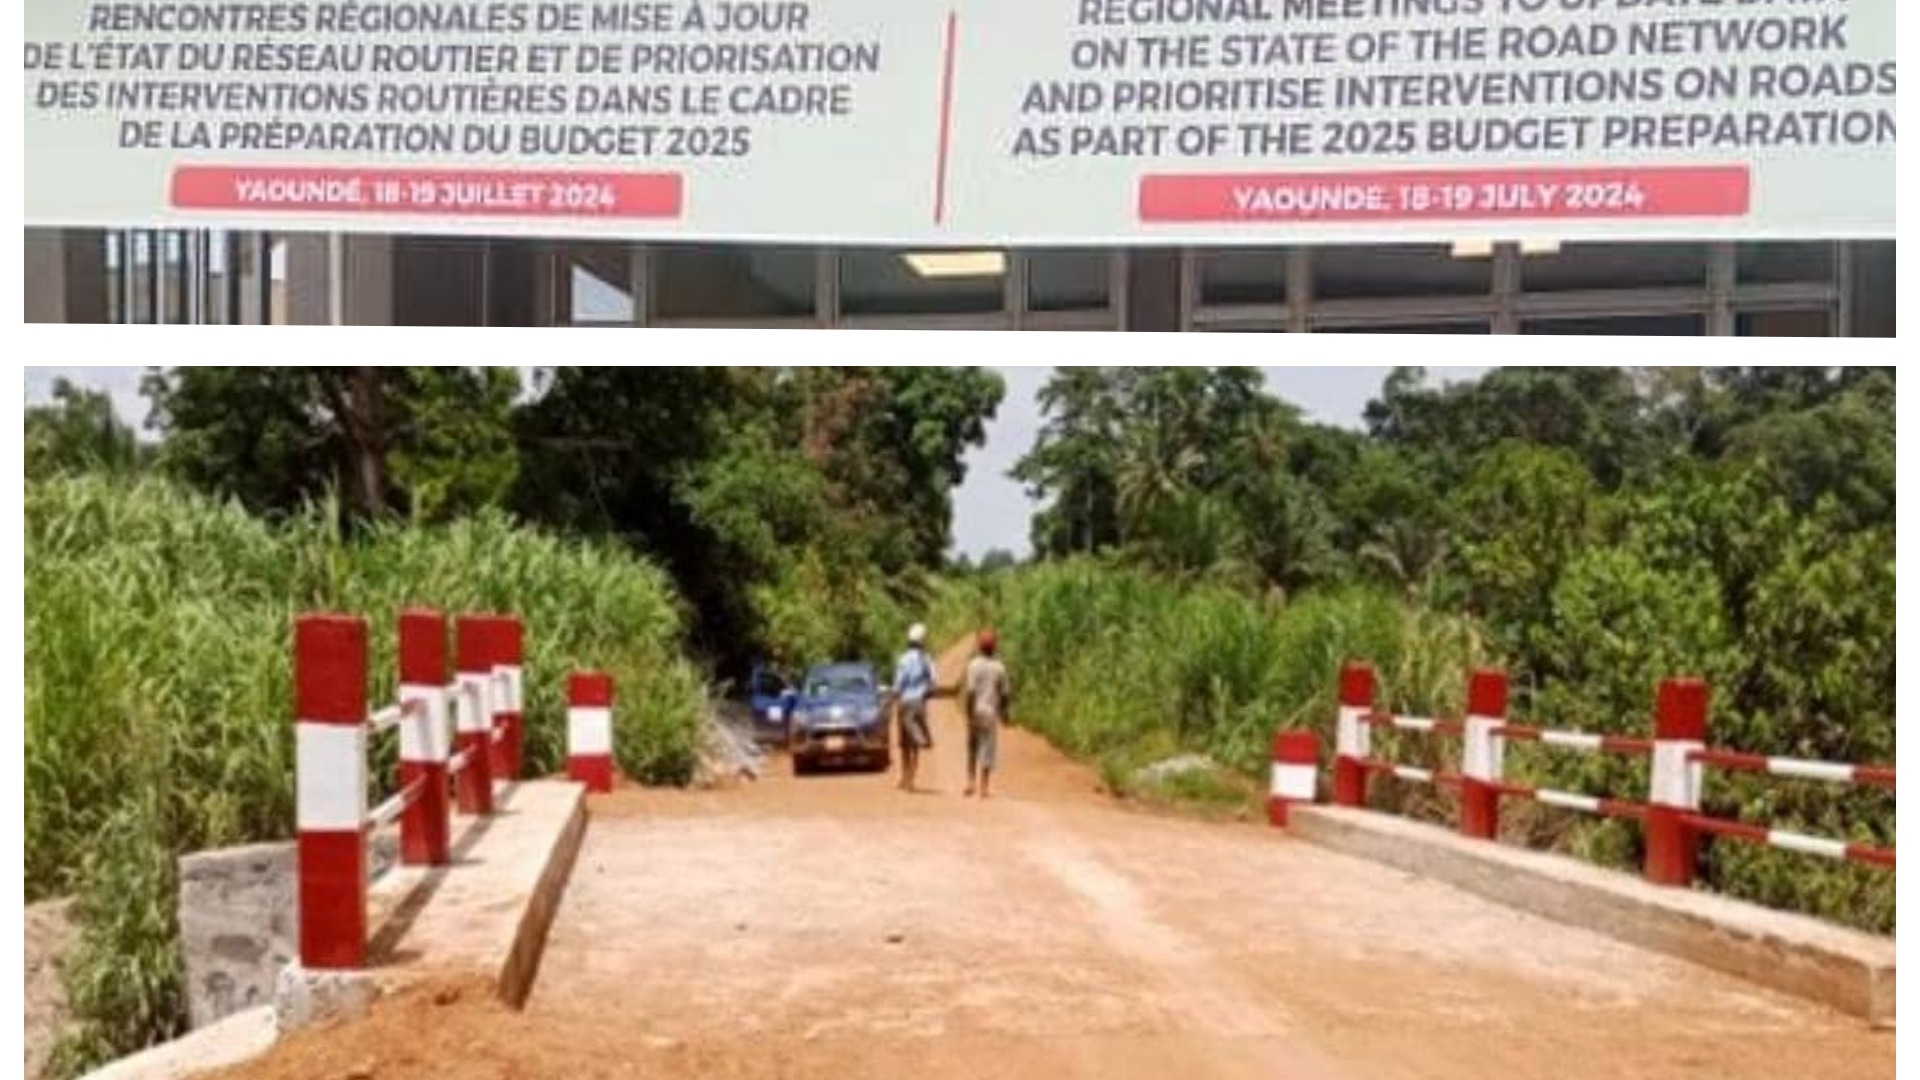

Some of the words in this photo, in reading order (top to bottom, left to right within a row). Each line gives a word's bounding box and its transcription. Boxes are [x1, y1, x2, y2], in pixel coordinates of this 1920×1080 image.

[89, 4, 306, 32] RENCONTRES
[314, 1, 527, 33] RÉGIONALES
[536, 4, 582, 32] DE
[592, 4, 673, 32] MISE
[682, 0, 705, 32] À
[713, 3, 809, 32] JOUR
[1078, 0, 1271, 25] REGIONAL
[24, 42, 62, 69] DE
[70, 37, 172, 70] L'ÉTAT
[177, 43, 225, 70] DU
[232, 37, 363, 72] RÉSEAU
[372, 44, 519, 73] ROUTIER
[526, 46, 570, 73] ET
[575, 46, 623, 74] DE
[631, 43, 880, 74] PRIORISATION
[1071, 37, 1127, 70] ON
[1136, 36, 1210, 69] THE
[1220, 33, 1337, 66] STATE
[1346, 31, 1400, 62] OF
[1408, 27, 1488, 61] THE
[1498, 23, 1618, 60] ROAD
[1628, 15, 1848, 56] NETWORK
[36, 80, 98, 109] DES
[106, 81, 370, 112] INTERVENTIONS
[377, 75, 568, 113] ROUTIÈRES
[575, 84, 672, 114] DANS
[681, 86, 722, 115] LE
[728, 84, 852, 116] CADRE
[1021, 82, 1103, 114] AND
[1113, 77, 1325, 111] PRIORITISE
[1335, 67, 1664, 107] INTERVENTIONS
[1673, 65, 1738, 101] ON
[1749, 60, 1896, 98] ROADS
[119, 120, 162, 148] DE
[170, 121, 210, 148] LA
[219, 115, 454, 152] PRÉPARATION
[463, 124, 511, 153] DU
[520, 126, 660, 155] BUDGET
[665, 126, 751, 156] 2025
[1012, 127, 1061, 156] AS
[1070, 125, 1168, 156] PART
[1177, 123, 1228, 155] OF
[1238, 123, 1313, 155] THE
[1322, 119, 1415, 154] 2025
[1427, 116, 1592, 151] BUDGET
[1602, 109, 1896, 148] PREPARATION
[372, 181, 433, 203] 18-19
[440, 182, 545, 206] JUILLET
[549, 184, 616, 208] 2024
[1400, 184, 1473, 208] 18-19
[1479, 184, 1556, 208] JULY
[1564, 183, 1644, 207] 2024
